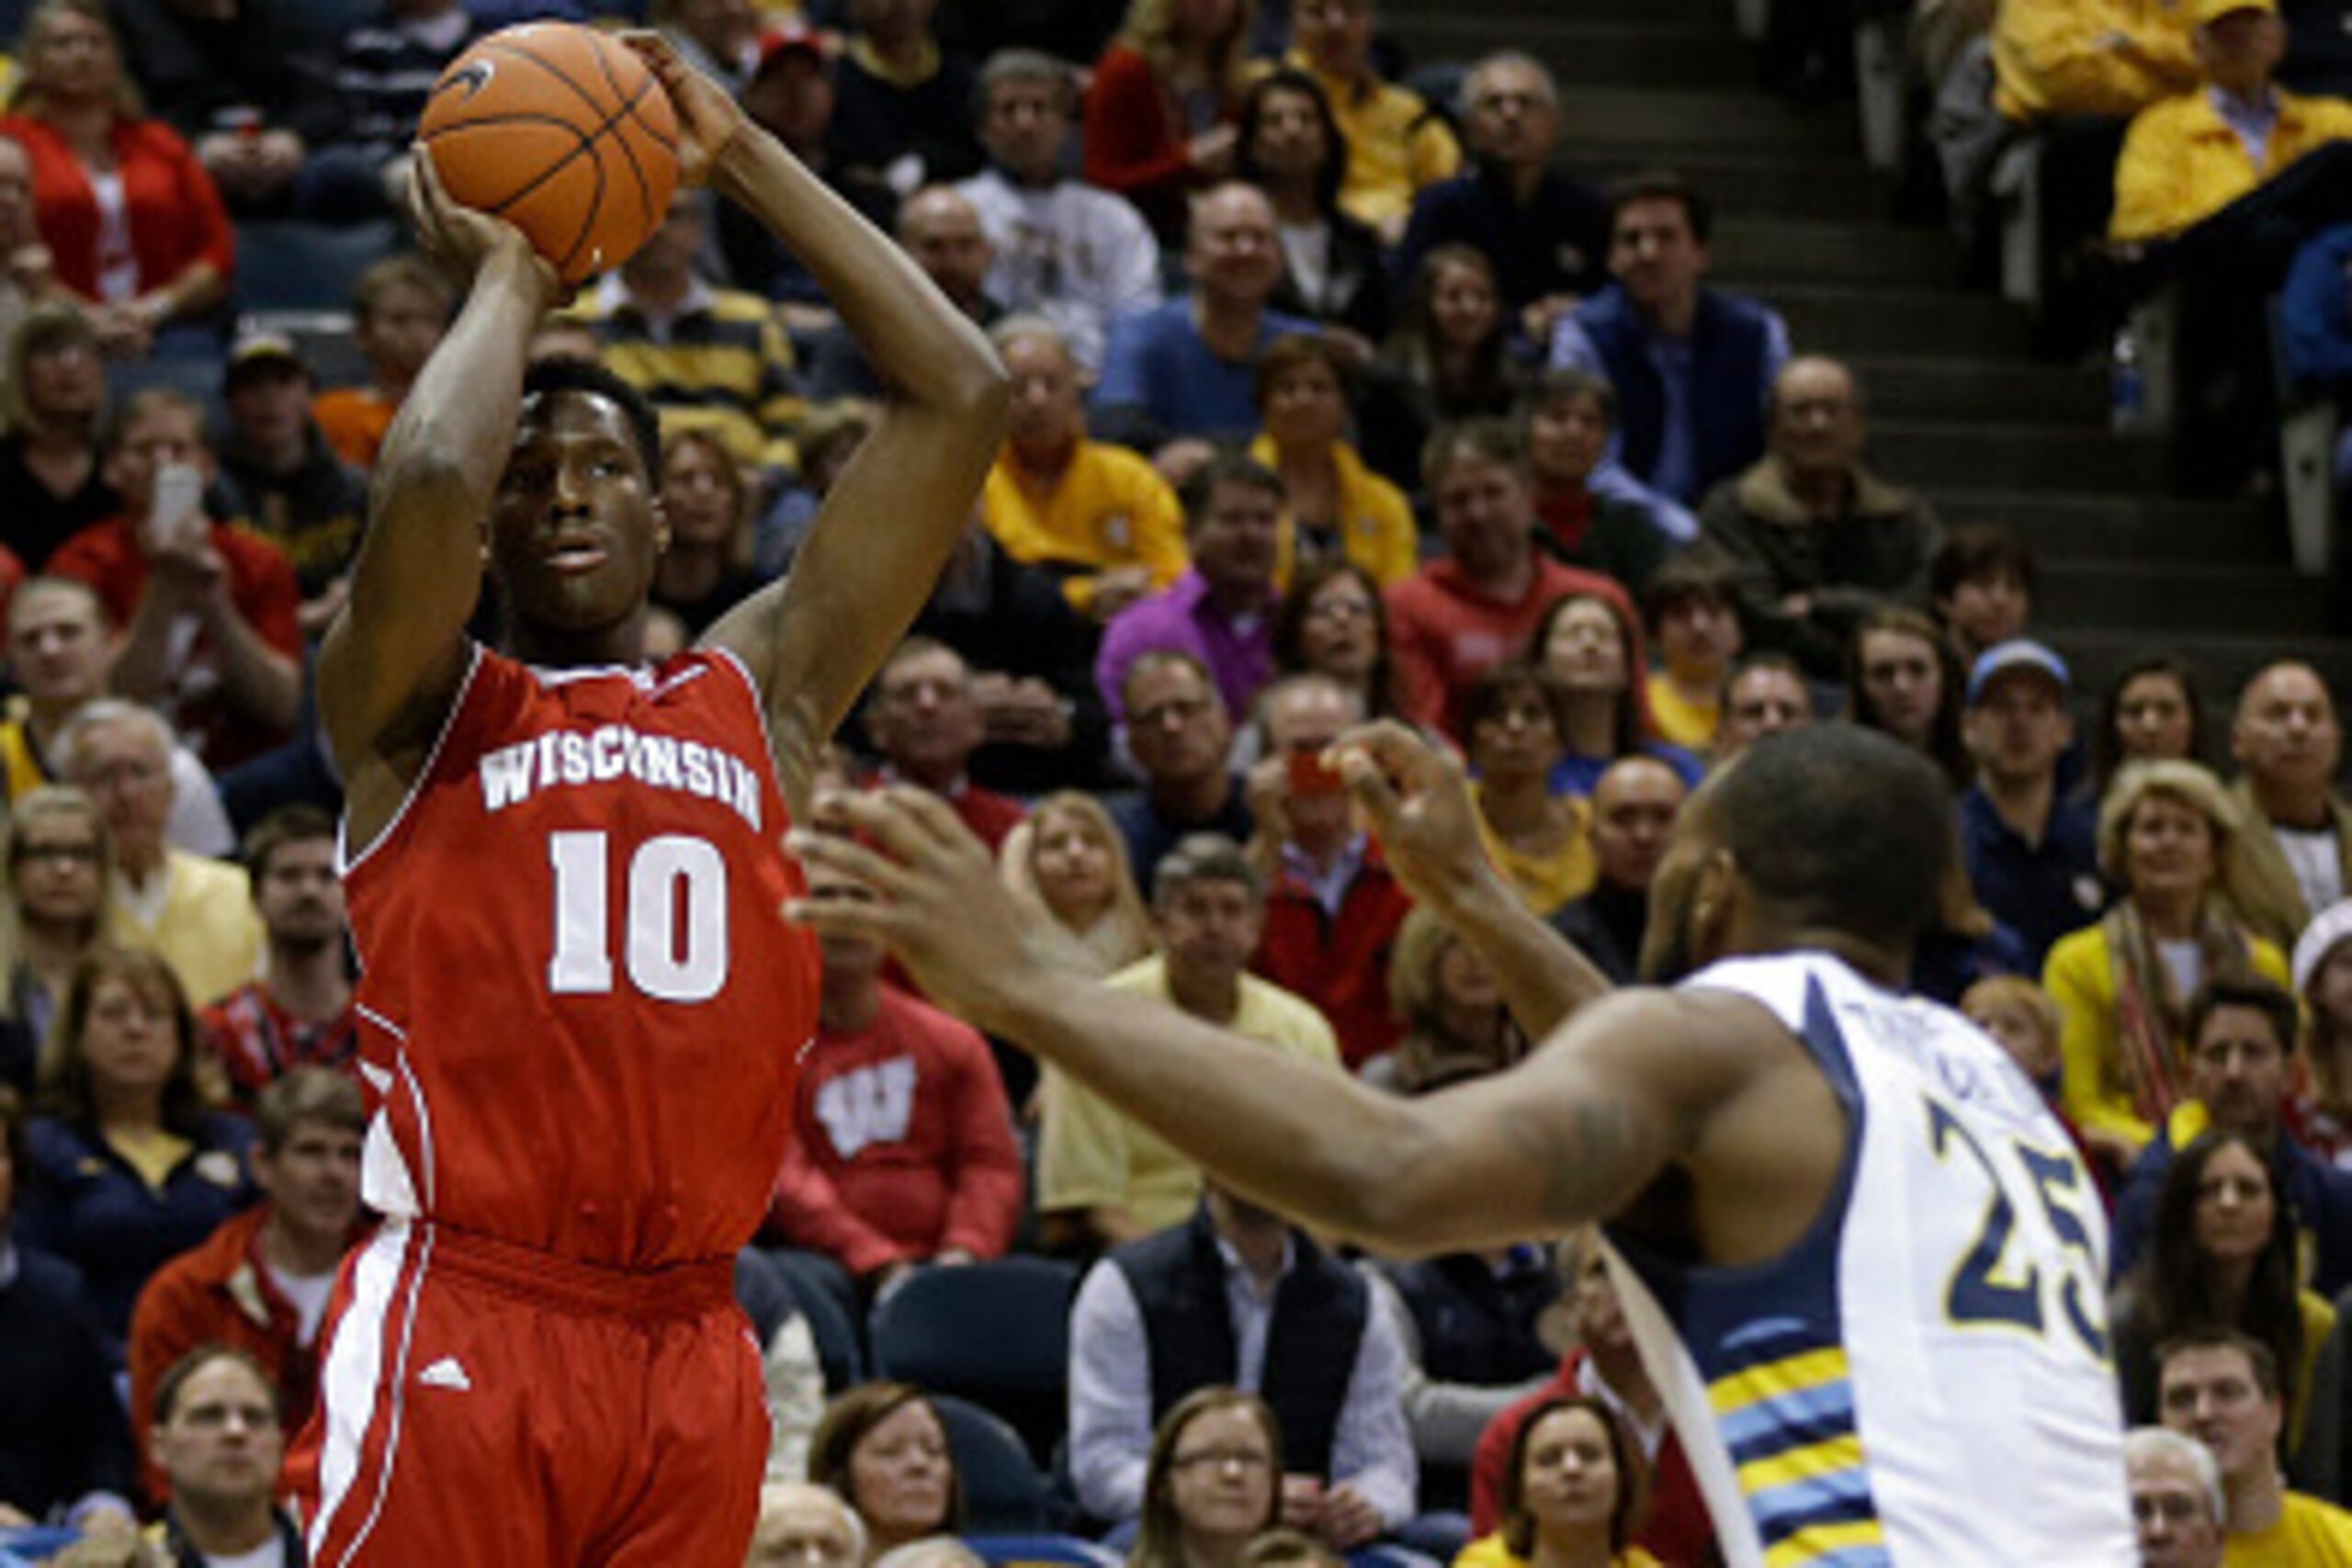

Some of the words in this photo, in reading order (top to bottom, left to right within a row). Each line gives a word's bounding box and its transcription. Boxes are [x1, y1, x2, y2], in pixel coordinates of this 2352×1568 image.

[548, 829, 728, 1002] 10
[815, 1055, 917, 1158] W
[1918, 1091, 2110, 1360] 25
